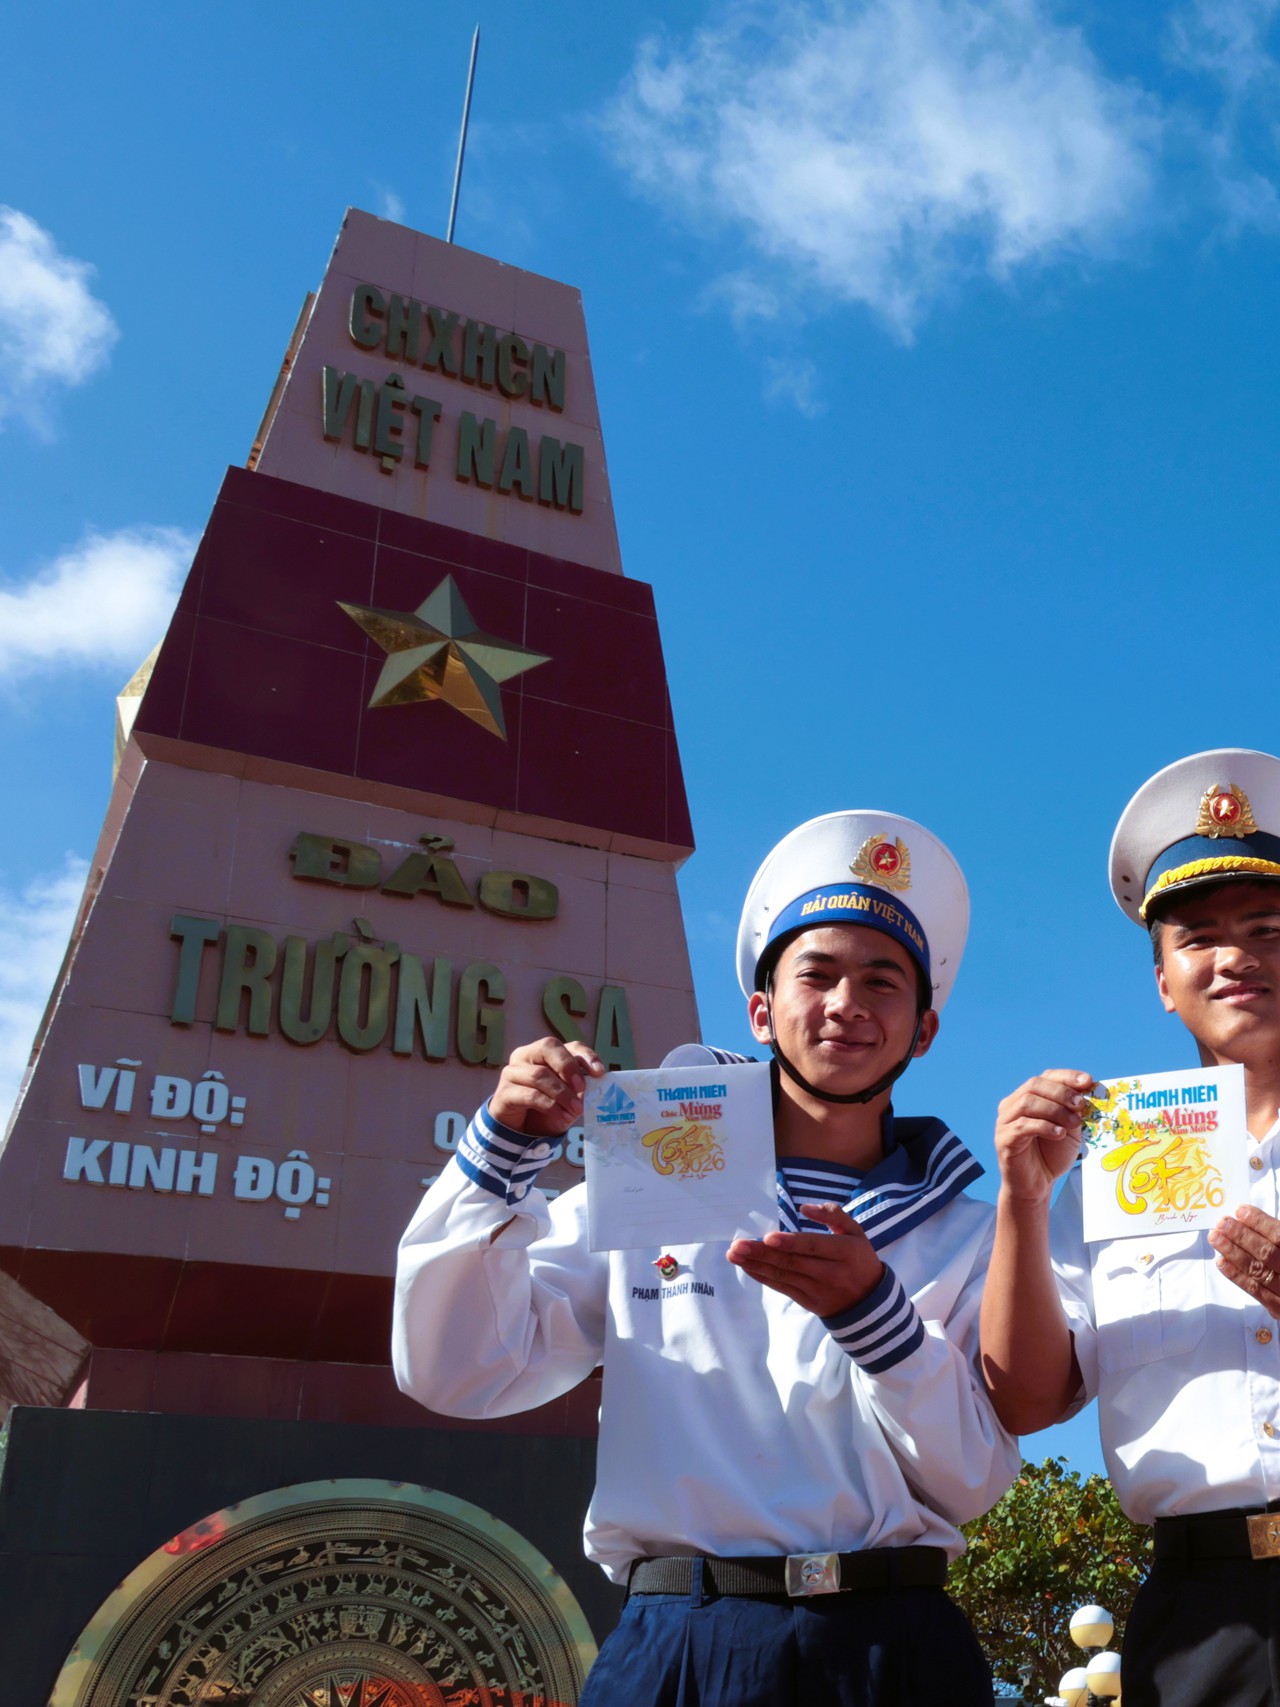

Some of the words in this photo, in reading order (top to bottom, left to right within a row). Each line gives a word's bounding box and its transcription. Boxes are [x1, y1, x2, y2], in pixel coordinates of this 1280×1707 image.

[349, 284, 567, 414] CHXHCN
[322, 365, 442, 475] VIỆT
[456, 411, 585, 516] NAM
[290, 832, 560, 921] ĐẢO
[801, 894, 828, 916] HẢI
[828, 891, 871, 911] QUÂN
[873, 900, 904, 926] VIỆT
[903, 921, 925, 952] NAM
[169, 915, 505, 1068] TRƯỜNG
[541, 976, 638, 1070] SA
[78, 1058, 143, 1115] VĨ
[150, 1070, 247, 1134] ĐỘ:
[656, 1086, 698, 1102] THANH
[679, 1101, 722, 1119] Mừng
[1126, 1088, 1179, 1110] THANH
[1161, 1108, 1218, 1131] Mừng
[63, 1136, 219, 1197] KINH
[233, 1150, 332, 1221] ĐỘ:
[677, 1150, 725, 1174] 2026
[1153, 1177, 1226, 1213] 2026
[631, 1286, 659, 1303] PHẠM
